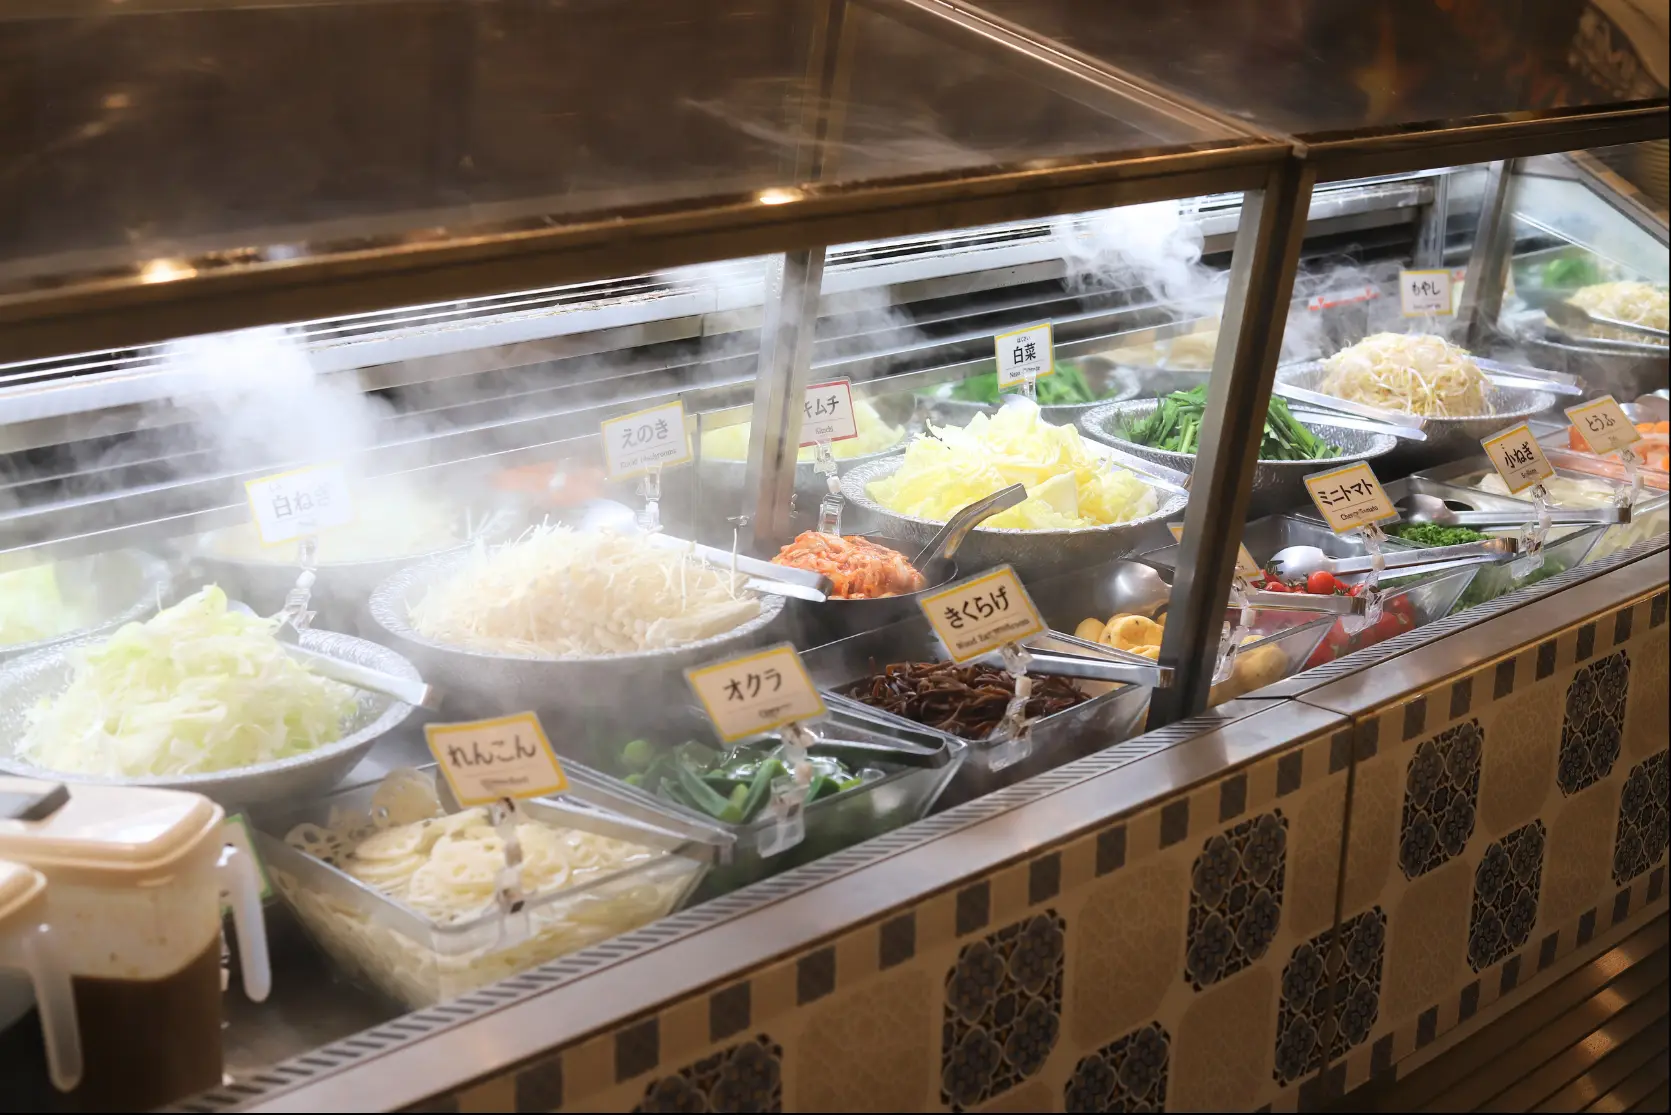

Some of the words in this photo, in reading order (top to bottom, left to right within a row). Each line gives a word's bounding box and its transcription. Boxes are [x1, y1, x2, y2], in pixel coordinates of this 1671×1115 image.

[1013, 342, 1036, 365] 白菜
[804, 394, 839, 418] キムチ
[622, 418, 669, 449] えのき
[1585, 412, 1616, 432] とうふ
[1504, 441, 1534, 469] 小ねぎ
[272, 481, 331, 518] 白ねぎ
[1317, 478, 1374, 506] ミニトマト
[944, 585, 1009, 630] きくらげ
[723, 668, 782, 701] オクラ
[448, 734, 537, 769] れんこん
